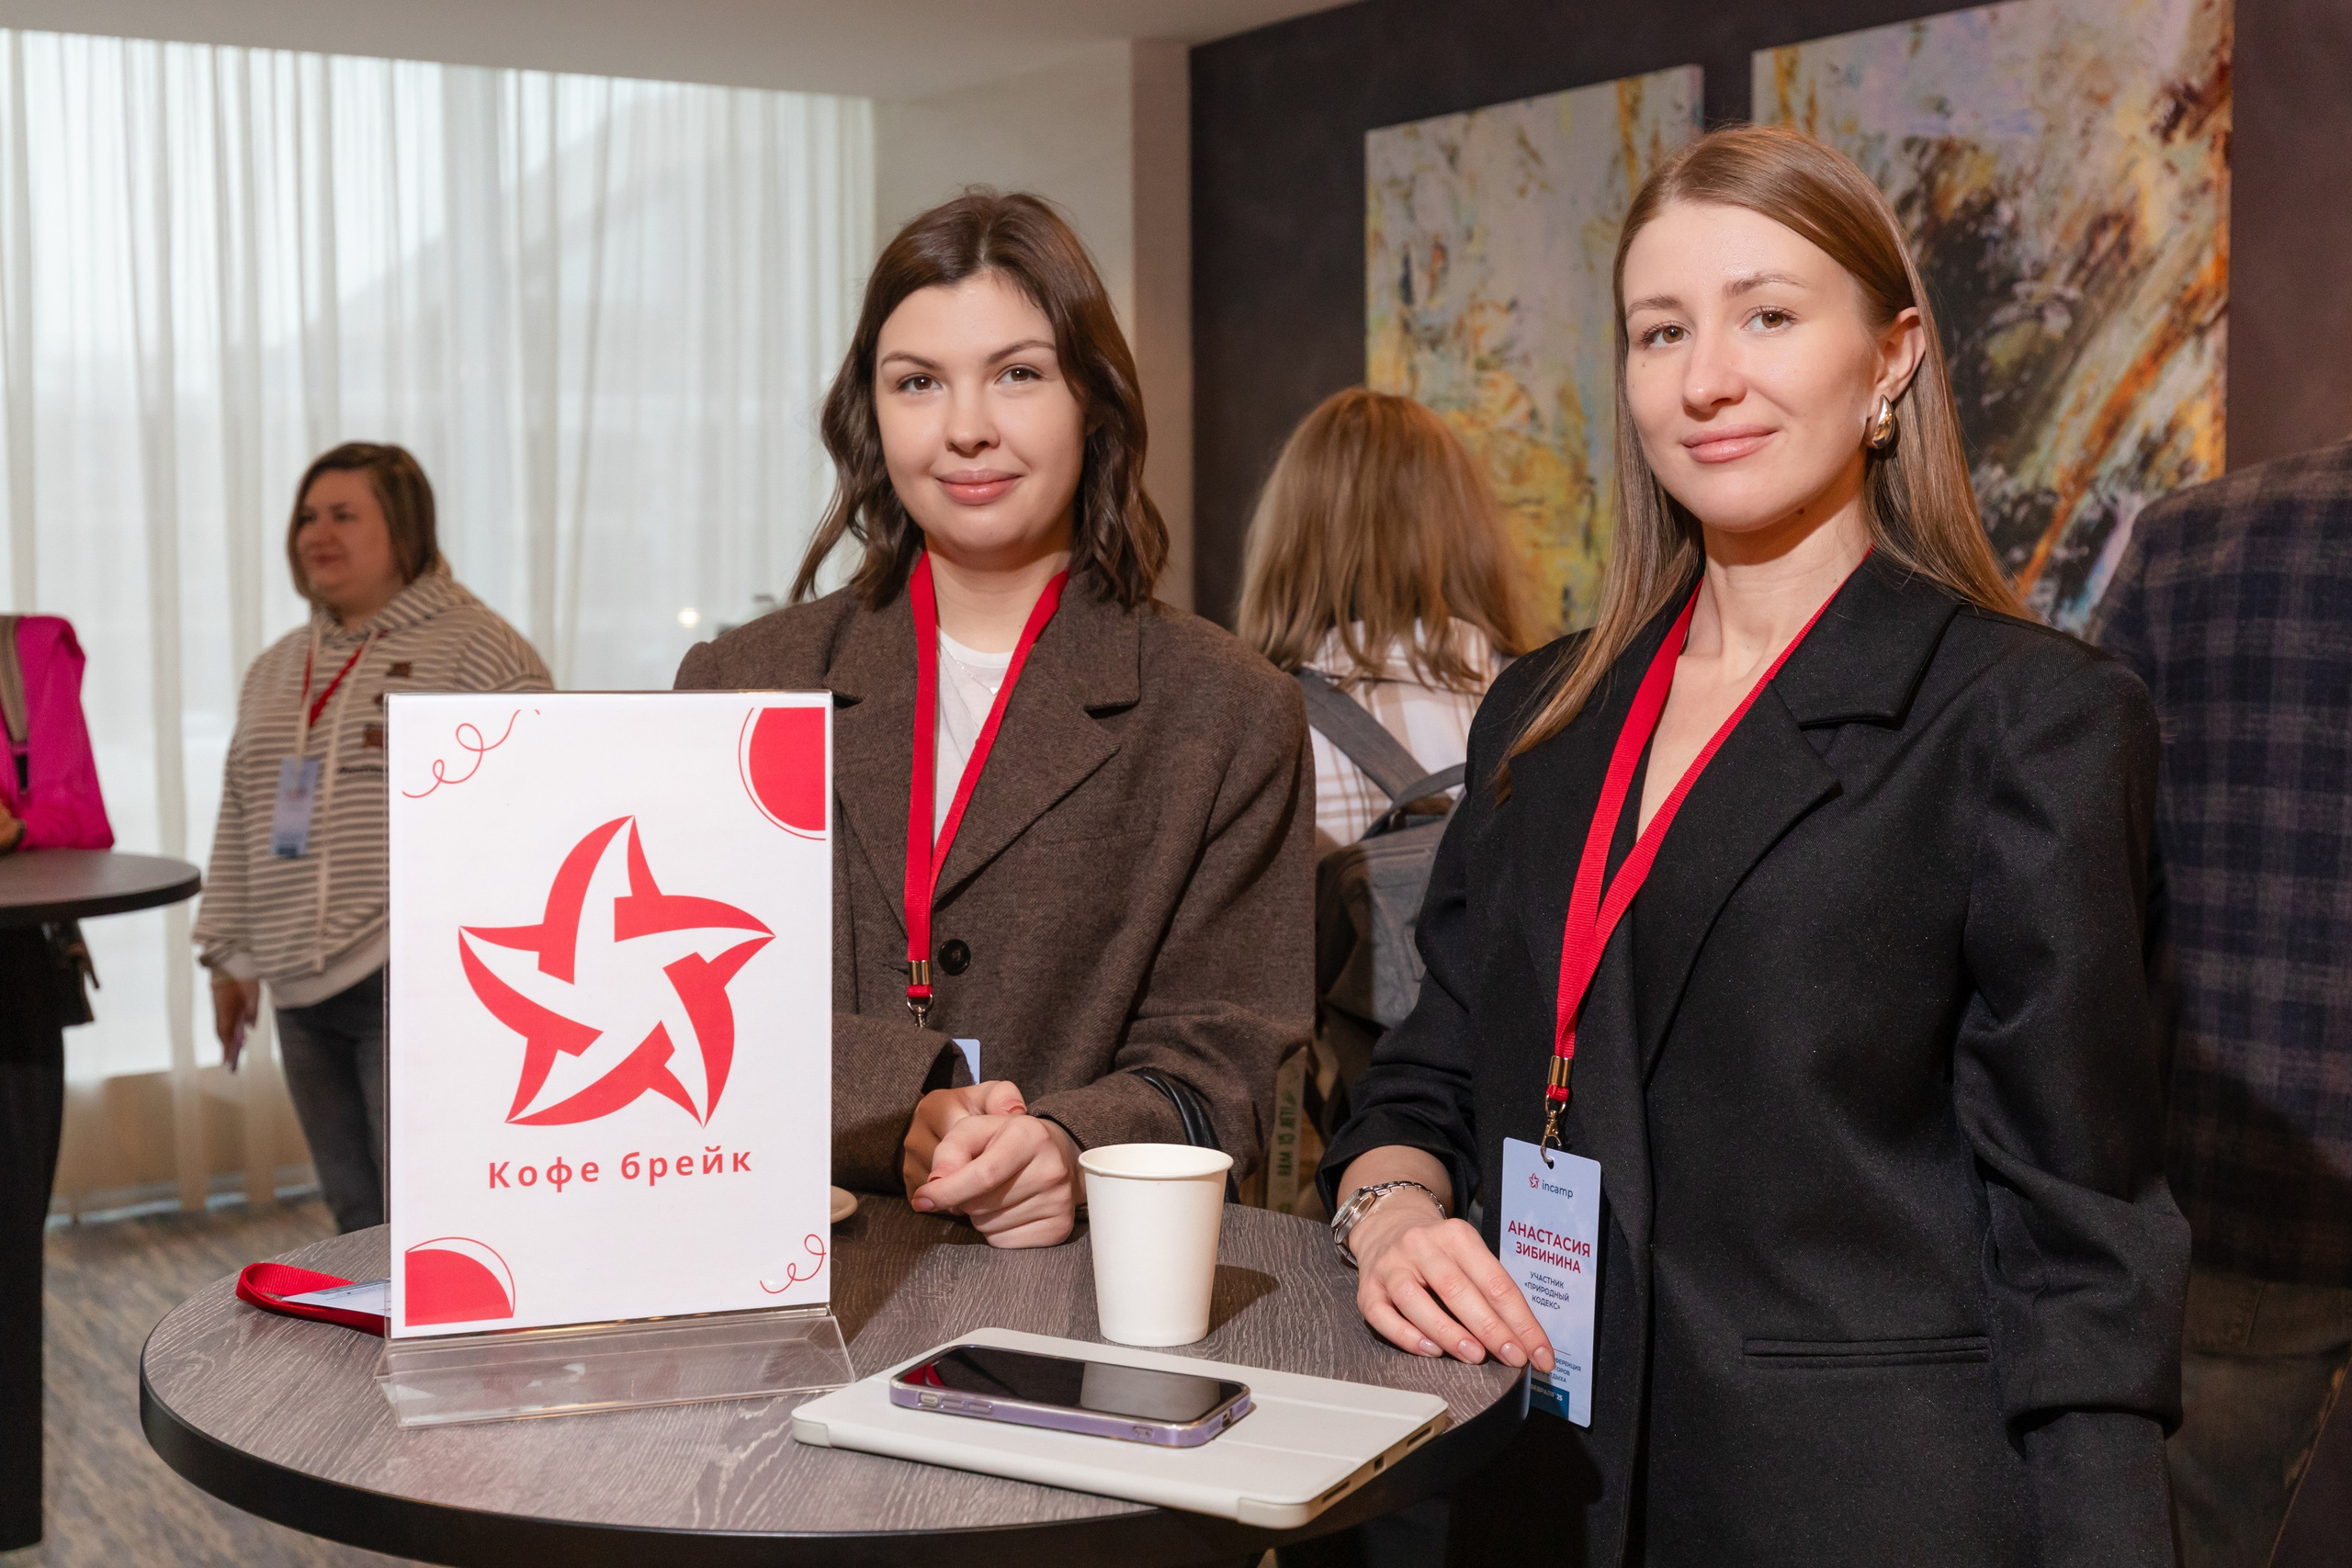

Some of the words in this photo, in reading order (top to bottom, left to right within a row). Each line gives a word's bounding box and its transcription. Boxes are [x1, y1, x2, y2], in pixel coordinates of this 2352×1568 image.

[489, 1156, 600, 1193] Кофе
[620, 1145, 752, 1187] брейк
[1542, 1180, 1574, 1200] incamp
[1508, 1220, 1590, 1258] АНАСТАСИЯ
[1516, 1241, 1581, 1274] ЗИБИНИНА
[1530, 1271, 1565, 1289] УЧАСТНИК
[1524, 1281, 1569, 1303] «ПРИРОДНЫЙ
[1532, 1295, 1561, 1311] КОДЕКС»
